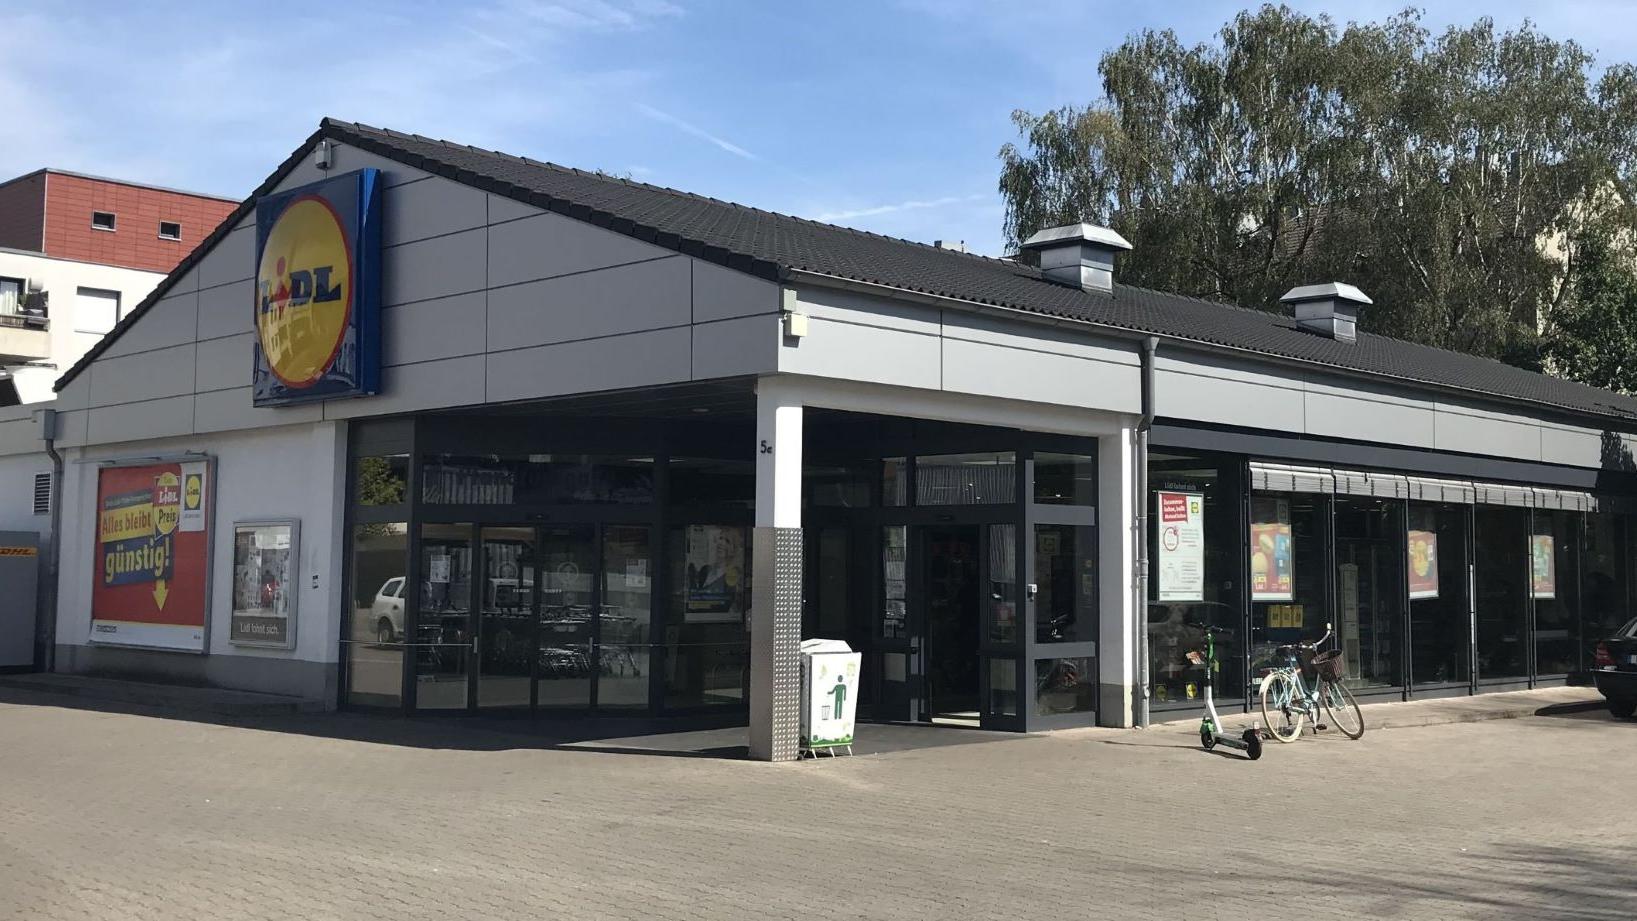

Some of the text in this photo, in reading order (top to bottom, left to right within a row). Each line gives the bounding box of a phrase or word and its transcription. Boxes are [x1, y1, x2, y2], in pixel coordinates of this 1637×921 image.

[102, 510, 152, 535] Alles bleibt
[158, 506, 177, 524] Preis
[105, 537, 169, 583] günstig!
